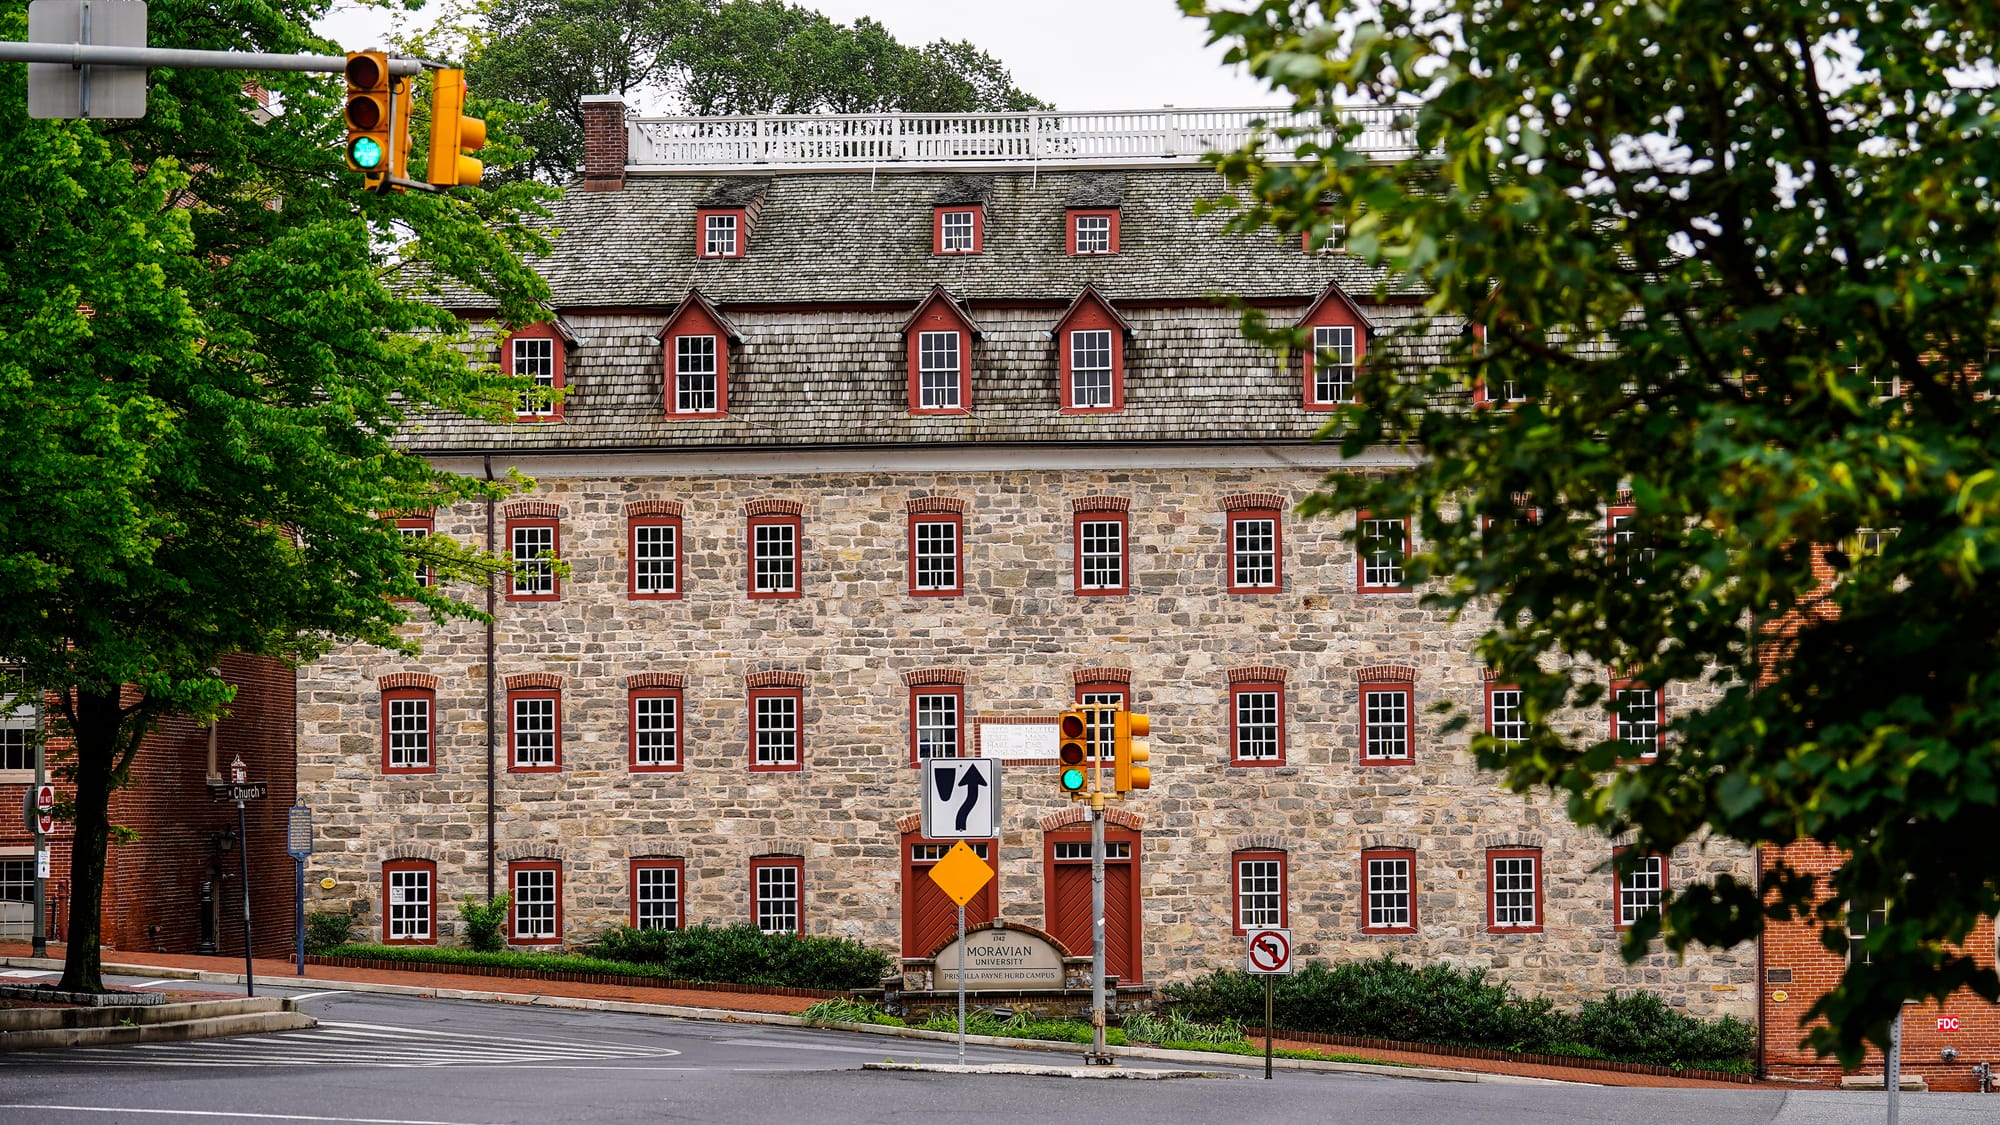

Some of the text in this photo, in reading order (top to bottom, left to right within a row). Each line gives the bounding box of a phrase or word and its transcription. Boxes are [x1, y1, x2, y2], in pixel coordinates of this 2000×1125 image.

[233, 785, 260, 799] Church
[967, 946, 1032, 957] MORAVIAN
[944, 972, 980, 980] PRISILLA
[1937, 1018, 1959, 1029] FDC
